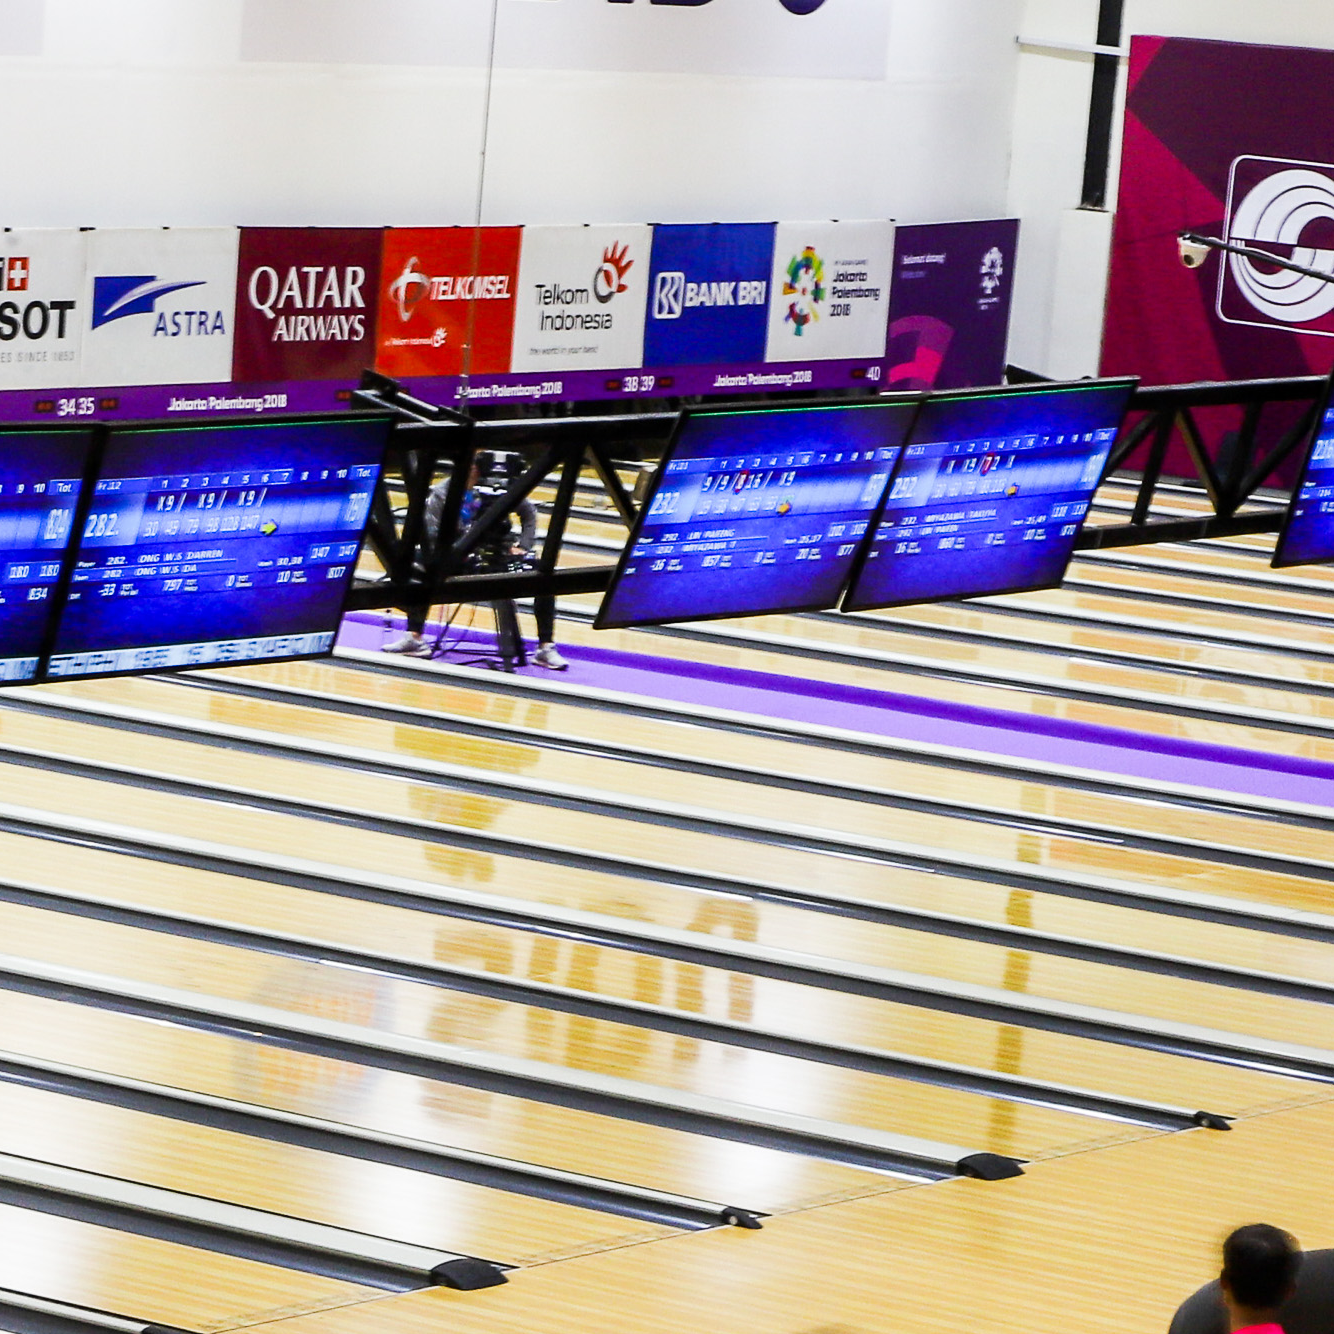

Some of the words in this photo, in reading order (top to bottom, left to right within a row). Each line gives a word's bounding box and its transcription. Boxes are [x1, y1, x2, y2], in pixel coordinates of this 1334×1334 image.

[248, 265, 366, 319] QATAR
[431, 275, 510, 300] TELKOMSEL
[534, 283, 589, 306] Telkom
[684, 282, 737, 307] BANK
[738, 281, 766, 305] BRI
[540, 309, 613, 331] Indonesia
[830, 304, 851, 317] 2018
[153, 311, 226, 338] ASTRA
[271, 314, 365, 342] AIRWAYS
[623, 377, 639, 392] 38
[640, 375, 655, 391] 39
[57, 398, 76, 416] 34
[77, 397, 95, 415] 35
[168, 397, 207, 413] Jakarta
[207, 396, 264, 412] Palembang
[264, 393, 287, 408] 2018
[83, 513, 119, 538] 282.
[186, 549, 224, 560] DARREN
[27, 587, 49, 601] 834
